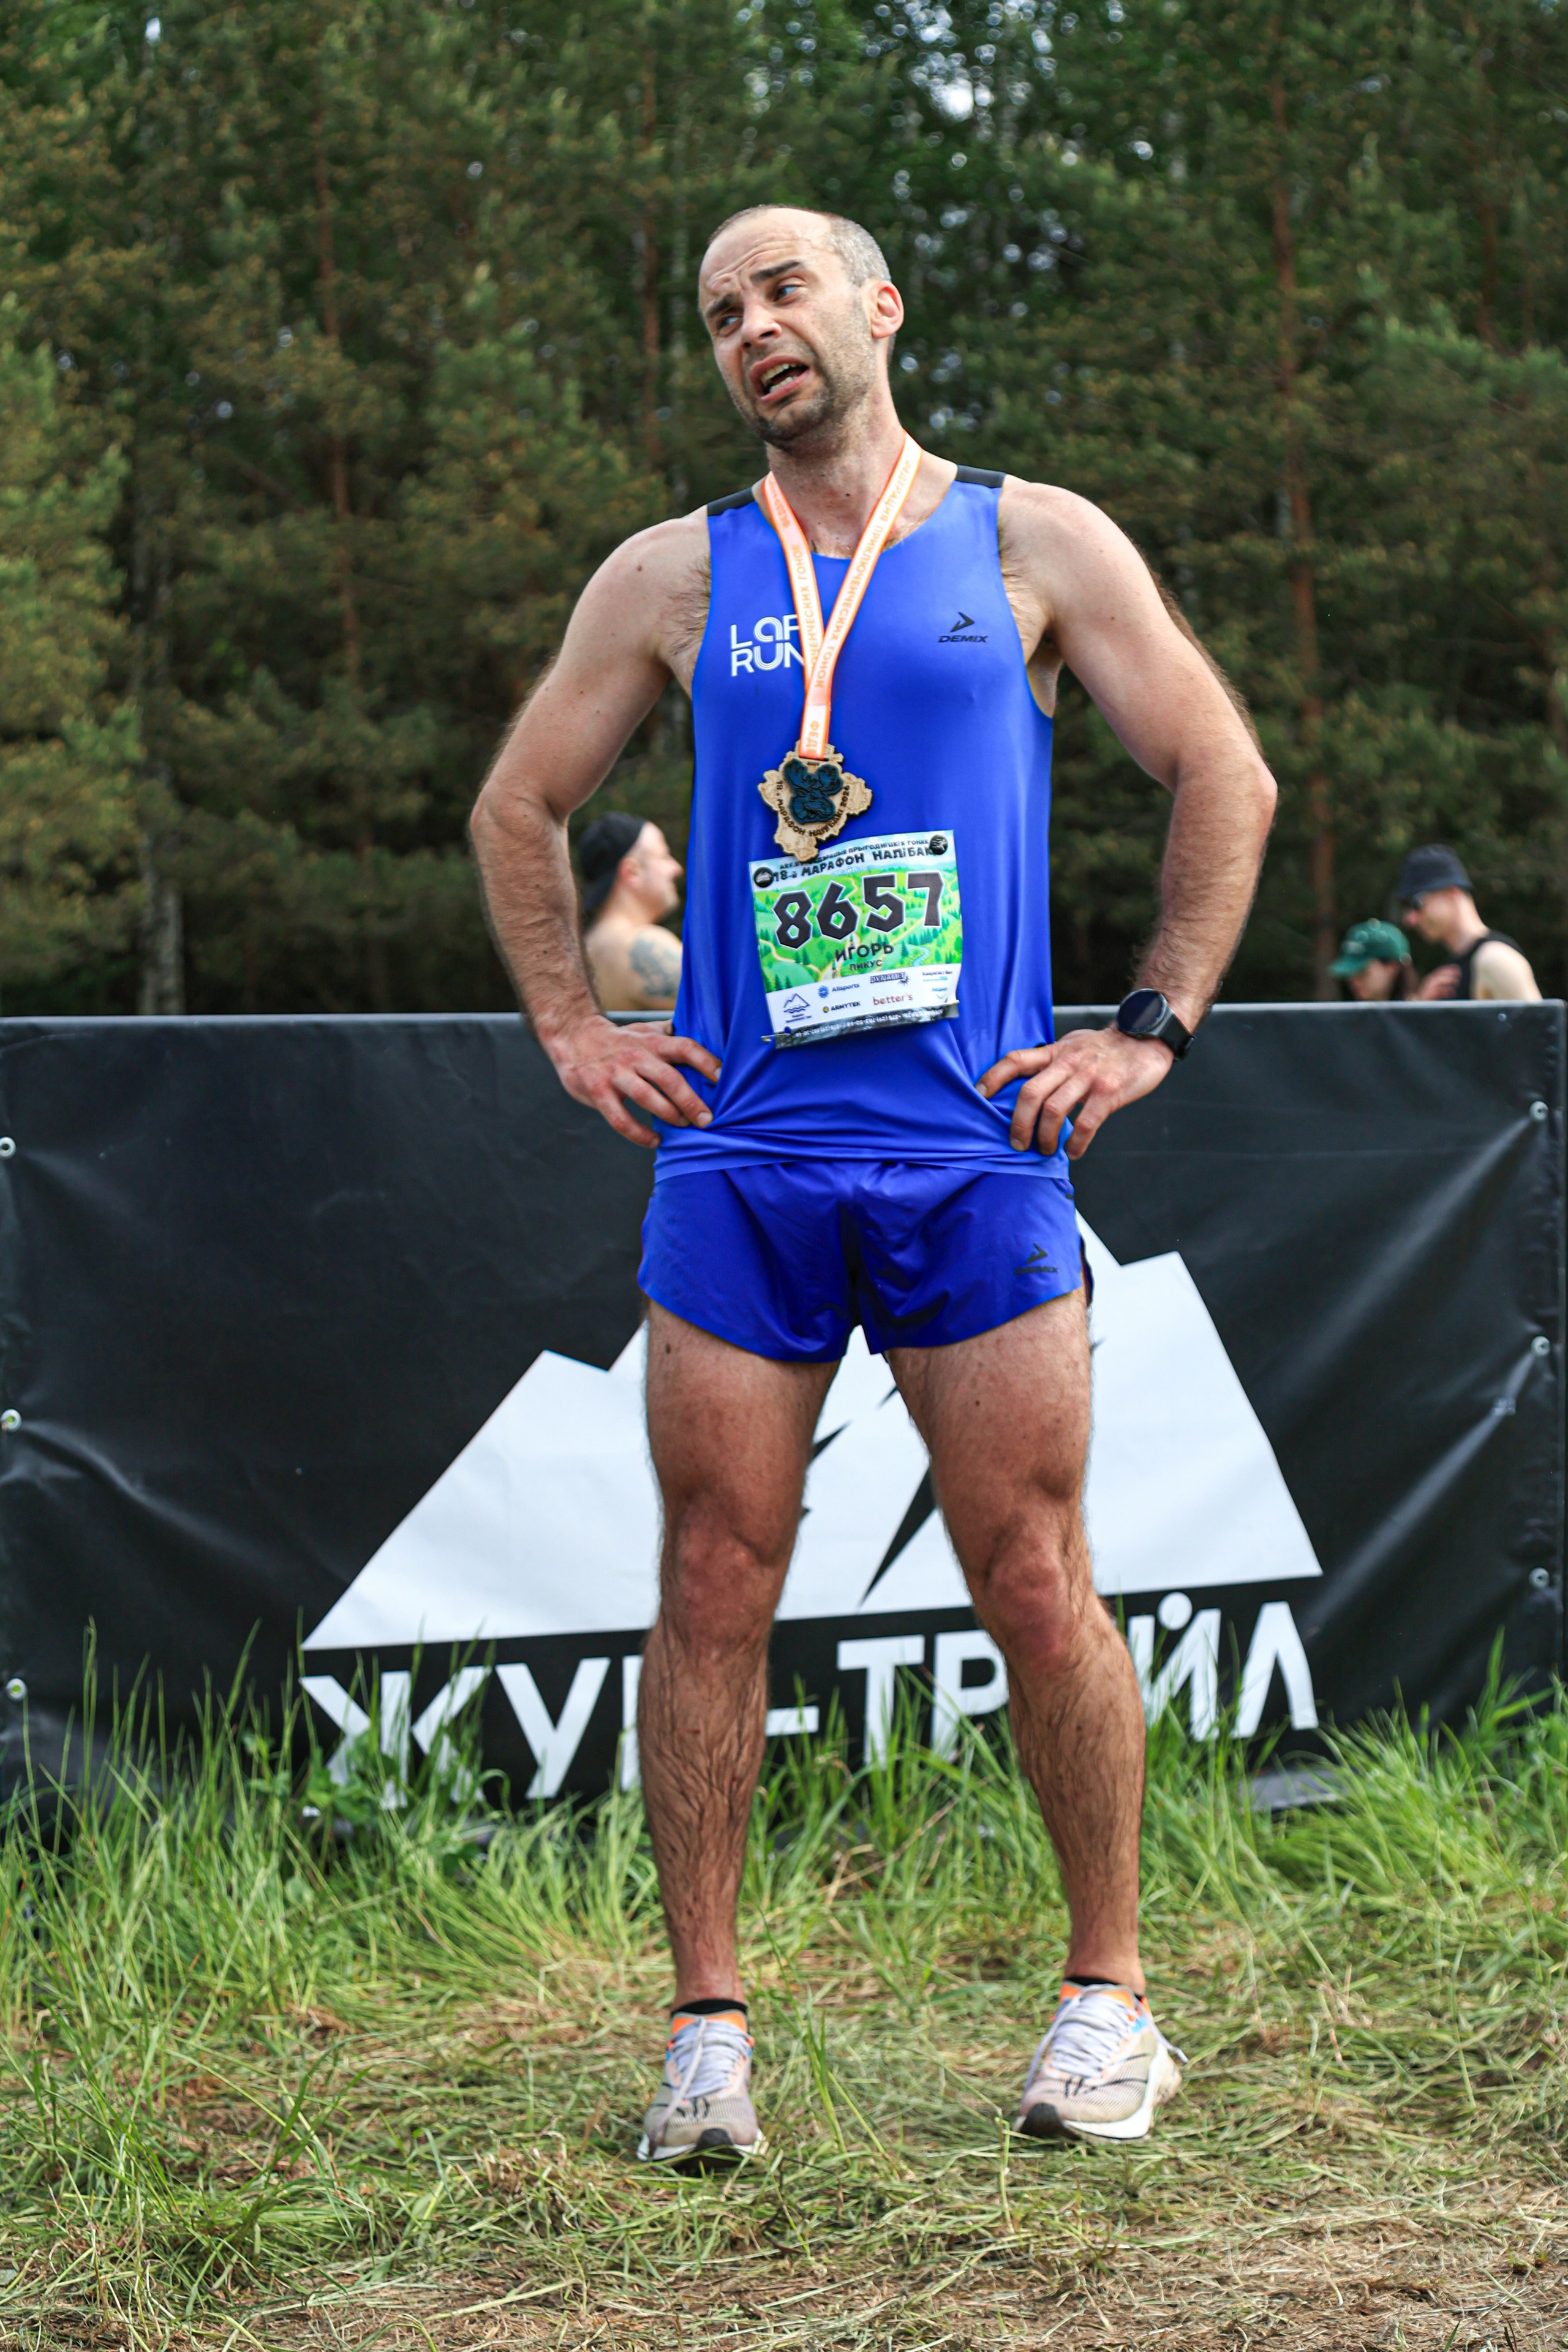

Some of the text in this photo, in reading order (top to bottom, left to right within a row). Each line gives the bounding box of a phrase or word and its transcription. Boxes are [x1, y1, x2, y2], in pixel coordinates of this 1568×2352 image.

[830, 526, 884, 640] ПРИКЛЮЧЕНЧЕСКИХ
[815, 646, 835, 687] ГОНОК
[777, 799, 806, 835] МАРАФОН
[801, 853, 865, 876] МАРАФОН
[772, 871, 944, 951] 8657
[835, 941, 894, 962] ИГОРЬ
[850, 959, 883, 971] ПИКУС
[299, 1592, 1319, 1809] ЖУ-ТРЙЛ
